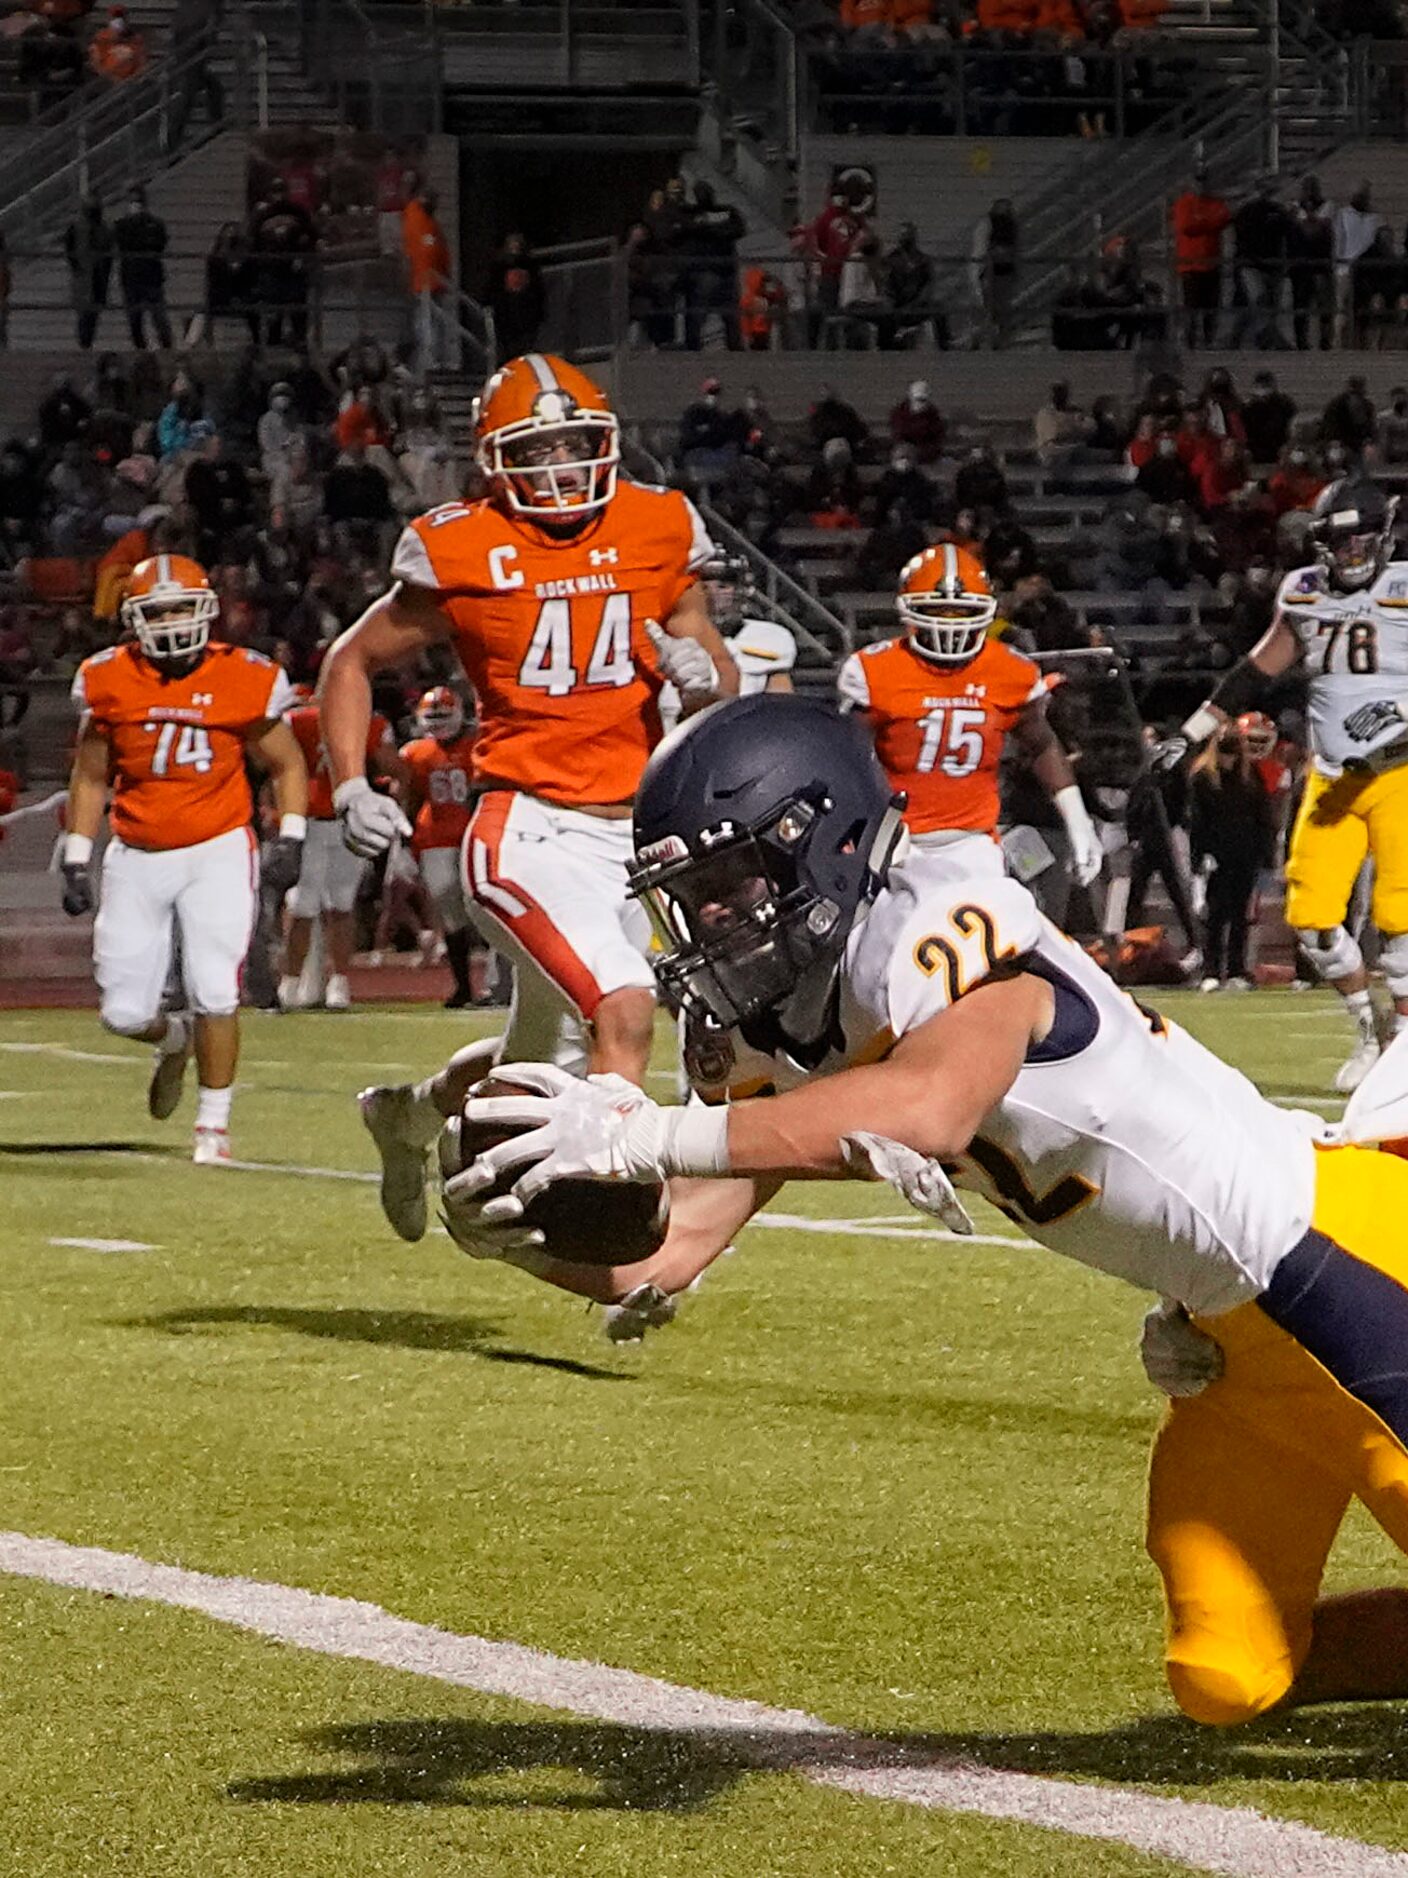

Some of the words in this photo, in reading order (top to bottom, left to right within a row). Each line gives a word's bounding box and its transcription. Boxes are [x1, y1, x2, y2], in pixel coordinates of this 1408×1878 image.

[488, 544, 525, 591] C
[534, 573, 618, 599] ROCKWALL
[518, 591, 636, 696] 44
[1318, 619, 1379, 674] 78
[143, 722, 213, 776] 74
[916, 708, 986, 778] 15
[912, 902, 1019, 1007] 22
